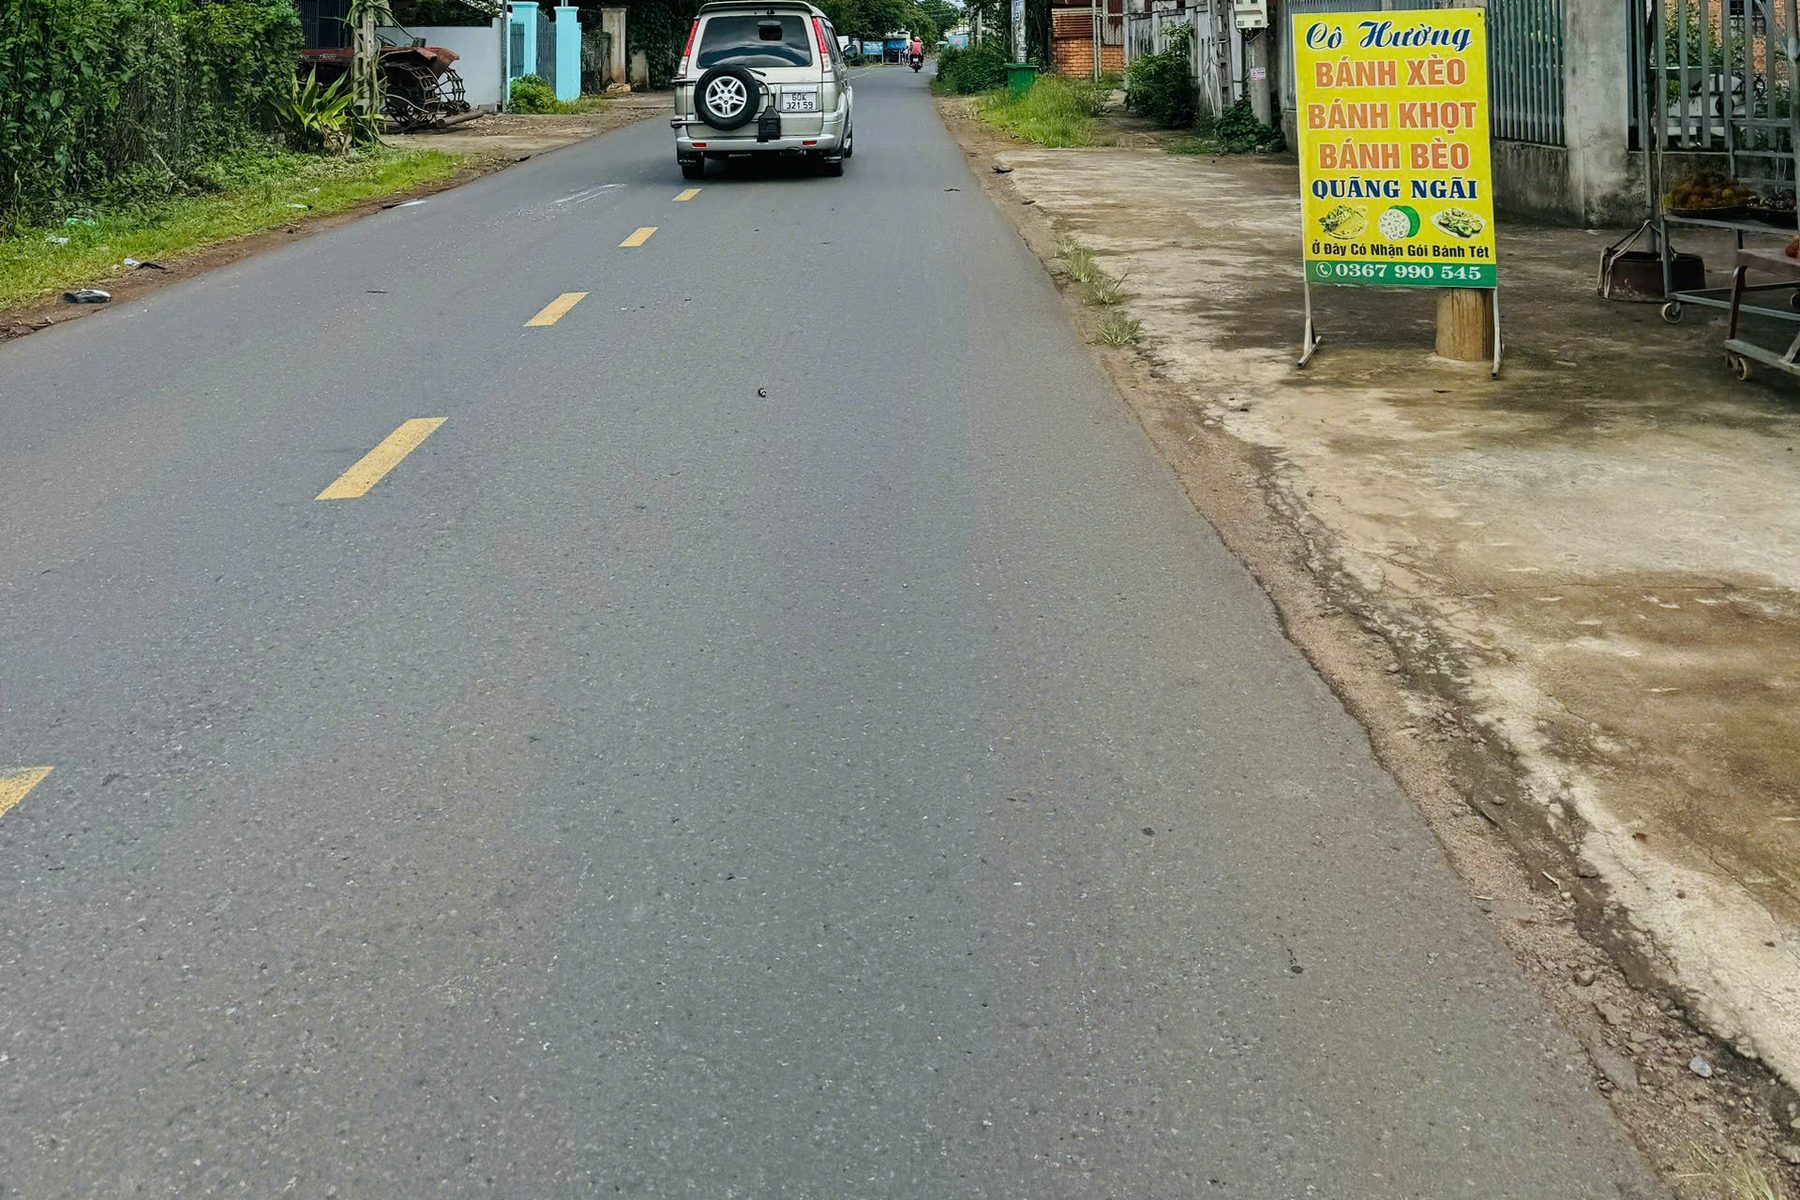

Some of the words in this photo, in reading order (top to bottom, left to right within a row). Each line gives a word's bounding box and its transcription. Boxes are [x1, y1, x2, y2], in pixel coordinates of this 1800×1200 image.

[1306, 22, 1344, 50] Cô
[1358, 21, 1473, 52] Hường
[1315, 56, 1397, 88] BÁNH
[1406, 53, 1466, 86] XÈO
[1308, 98, 1389, 129] BÁNH
[1399, 102, 1477, 134] KHỌT
[1319, 138, 1400, 170] BÁNH
[1410, 137, 1470, 170] BÈO
[1410, 176, 1478, 199] NGÃI
[1312, 239, 1320, 255] Ở
[1324, 243, 1347, 257] Đây
[1350, 243, 1367, 256] Có
[1370, 244, 1403, 259] Nhận
[1407, 245, 1428, 257] Gói
[1432, 245, 1465, 258] Bánh
[1469, 245, 1489, 259] Tét
[1335, 263, 1387, 278] 0367
[1394, 265, 1434, 279] 990
[1441, 266, 1482, 280] 545
